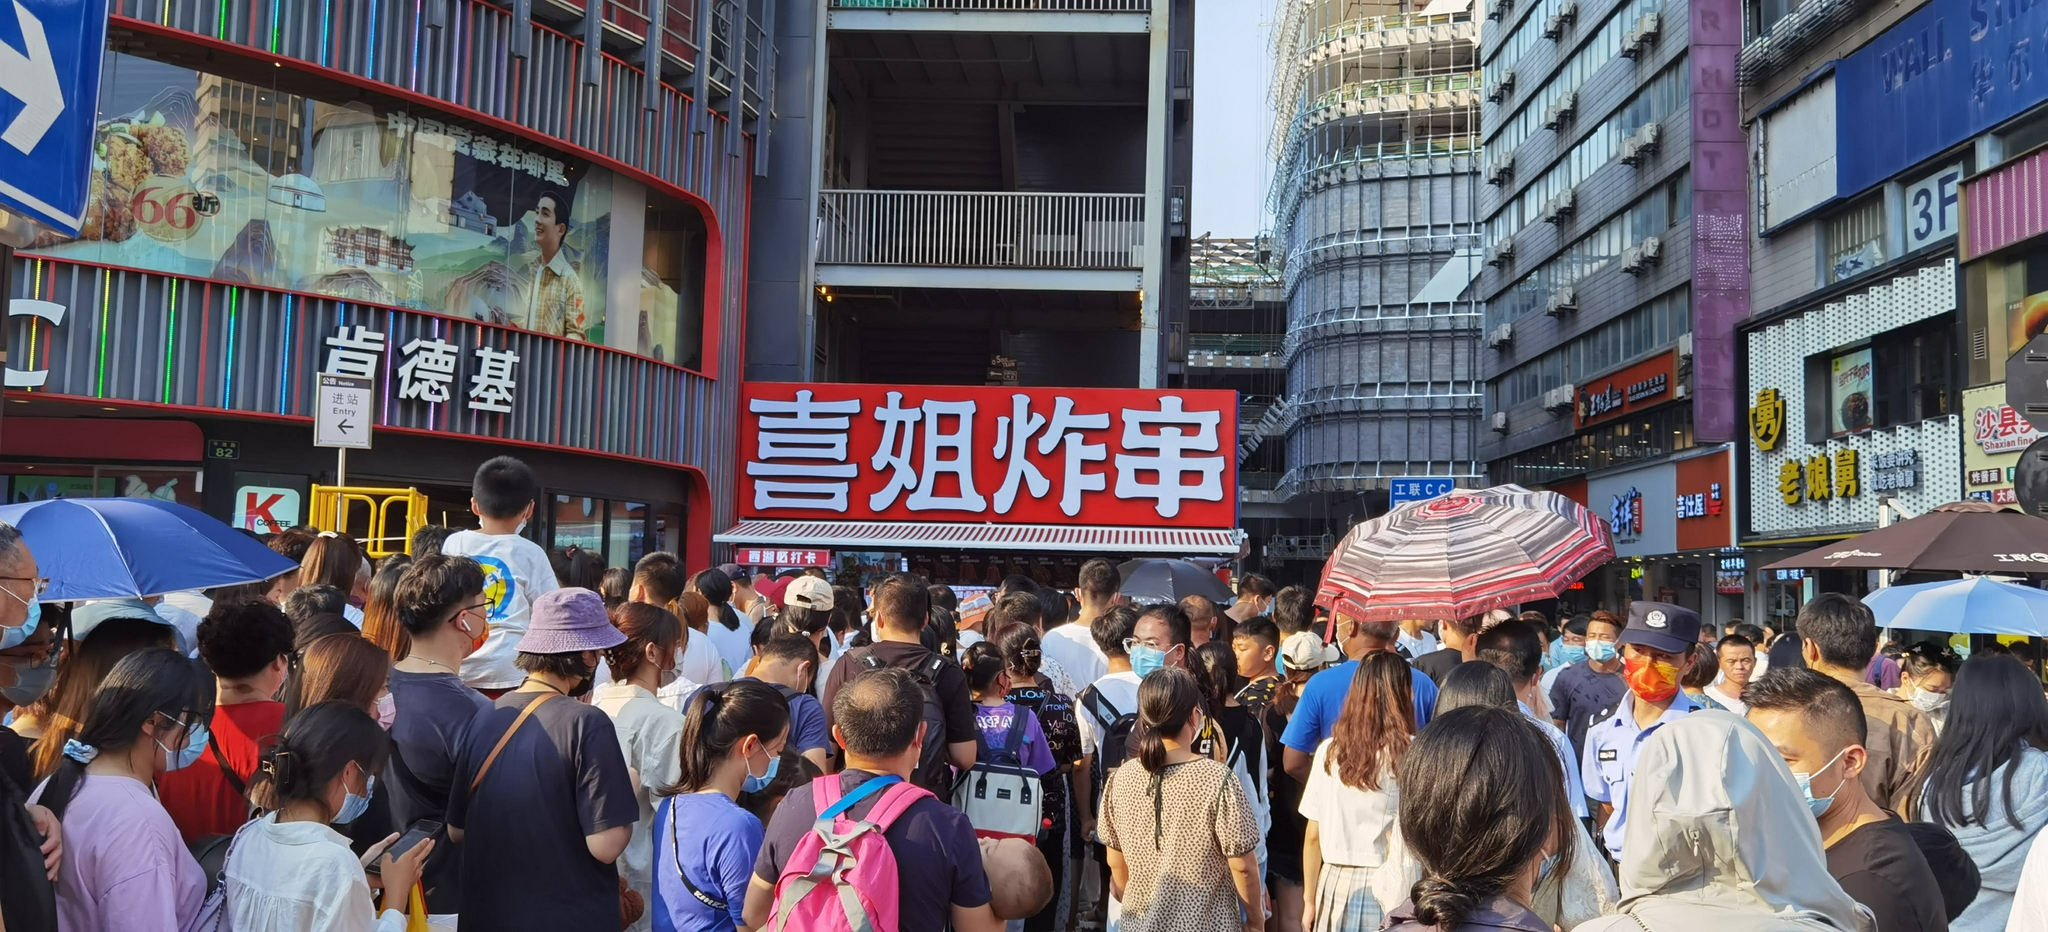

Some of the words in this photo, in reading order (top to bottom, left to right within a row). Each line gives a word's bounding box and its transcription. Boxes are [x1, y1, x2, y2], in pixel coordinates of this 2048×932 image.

[1880, 17, 1952, 96] WALL
[1913, 171, 1958, 241] 3F
[326, 325, 520, 414] 肯德基
[322, 377, 336, 386] 公告
[332, 393, 359, 406] 进站
[333, 407, 356, 417] Entry
[1984, 437, 2016, 451] Shaxian
[2018, 434, 2034, 446] fine
[216, 448, 233, 458] 82
[747, 389, 1225, 518] 喜姐炸串
[1778, 448, 1858, 506] 老娘舅
[245, 491, 286, 534] K
[256, 518, 291, 528] COFFEE
[748, 550, 817, 565] 西湖必打卡
